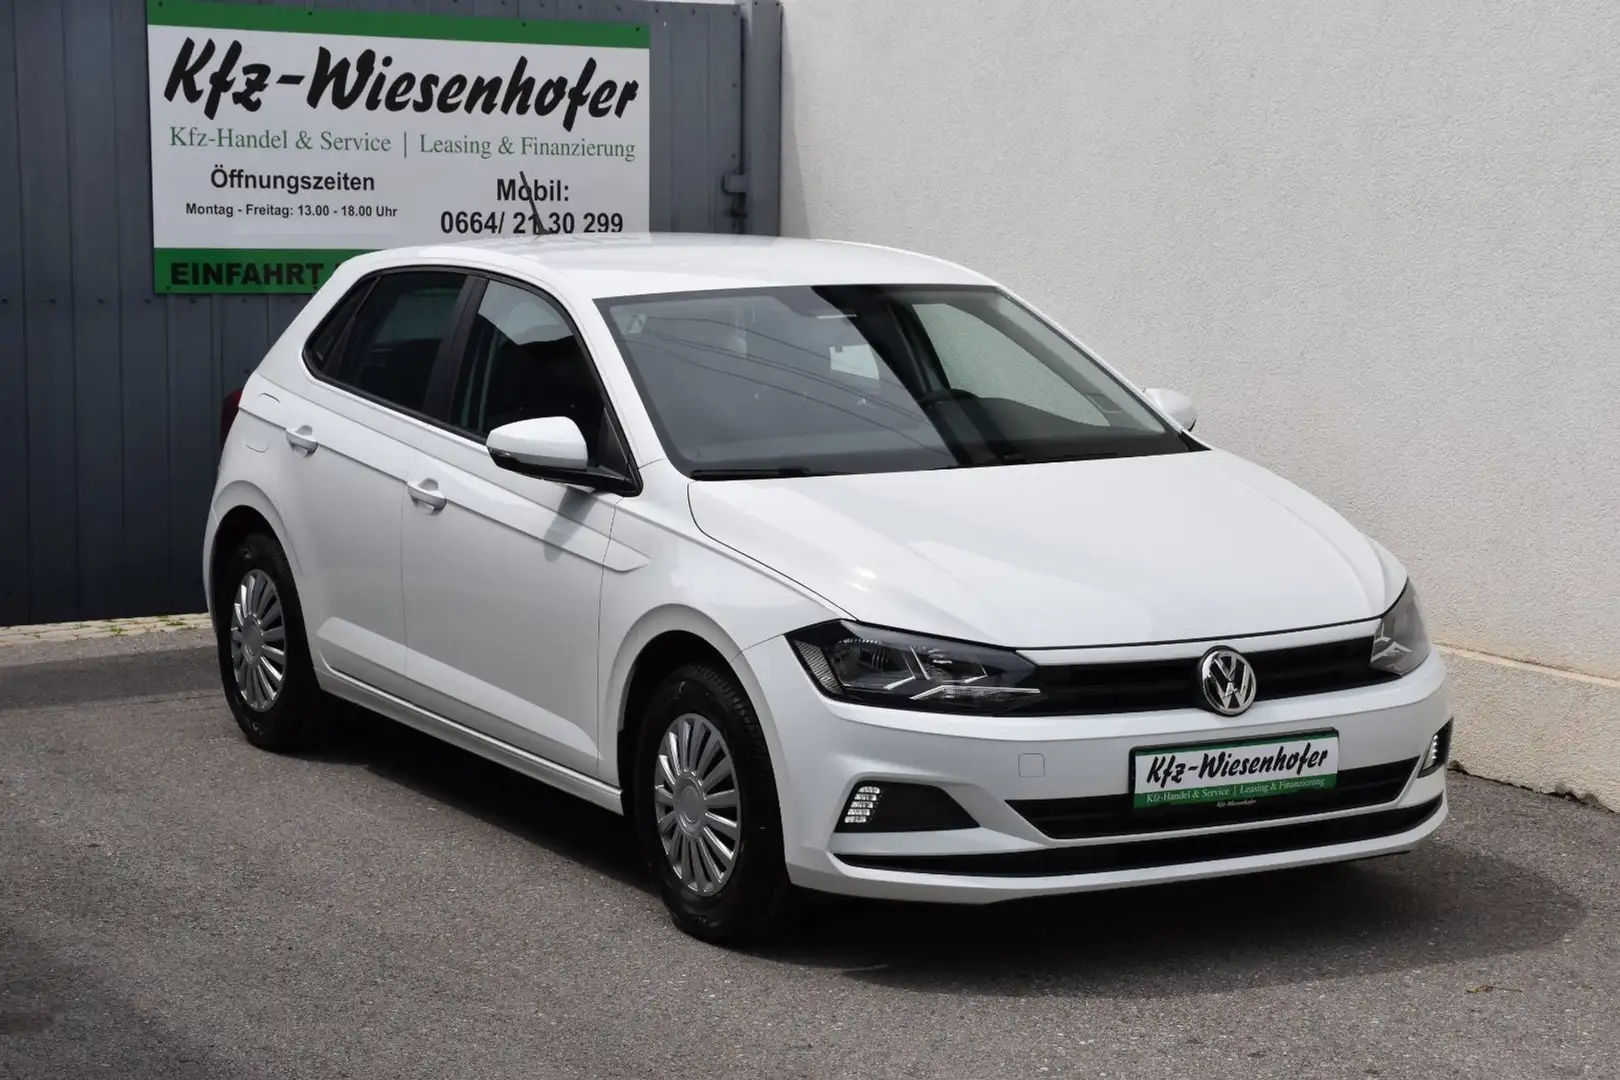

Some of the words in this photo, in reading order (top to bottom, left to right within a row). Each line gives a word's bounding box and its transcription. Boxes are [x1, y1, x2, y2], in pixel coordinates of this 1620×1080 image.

[163, 36, 640, 133] Kfz-Wiesenhofer
[169, 125, 288, 151] Kfz-Handel
[295, 131, 313, 150] &
[320, 131, 392, 152] Service
[420, 133, 492, 160] Leasing
[498, 136, 515, 155] &
[521, 136, 636, 162] Finanzierung
[210, 164, 375, 195] Öffnungszeiten
[496, 178, 570, 202] Mobil:
[185, 203, 234, 217] Montag
[245, 204, 294, 219] Freitag:
[298, 205, 330, 216] 13.00
[341, 206, 373, 217] 18.00
[376, 206, 398, 217] Uhr
[440, 211, 505, 234] 0664/
[548, 212, 576, 234] 30
[583, 213, 624, 233] 299
[170, 262, 324, 286] EINFAHRT
[1146, 742, 1329, 788] Kfz-Wiesenhofer
[1146, 790, 1191, 803] Kfz-Handel
[1202, 786, 1230, 798] Service
[1239, 781, 1270, 794] Leasing
[1279, 777, 1326, 791] Finanzierung
